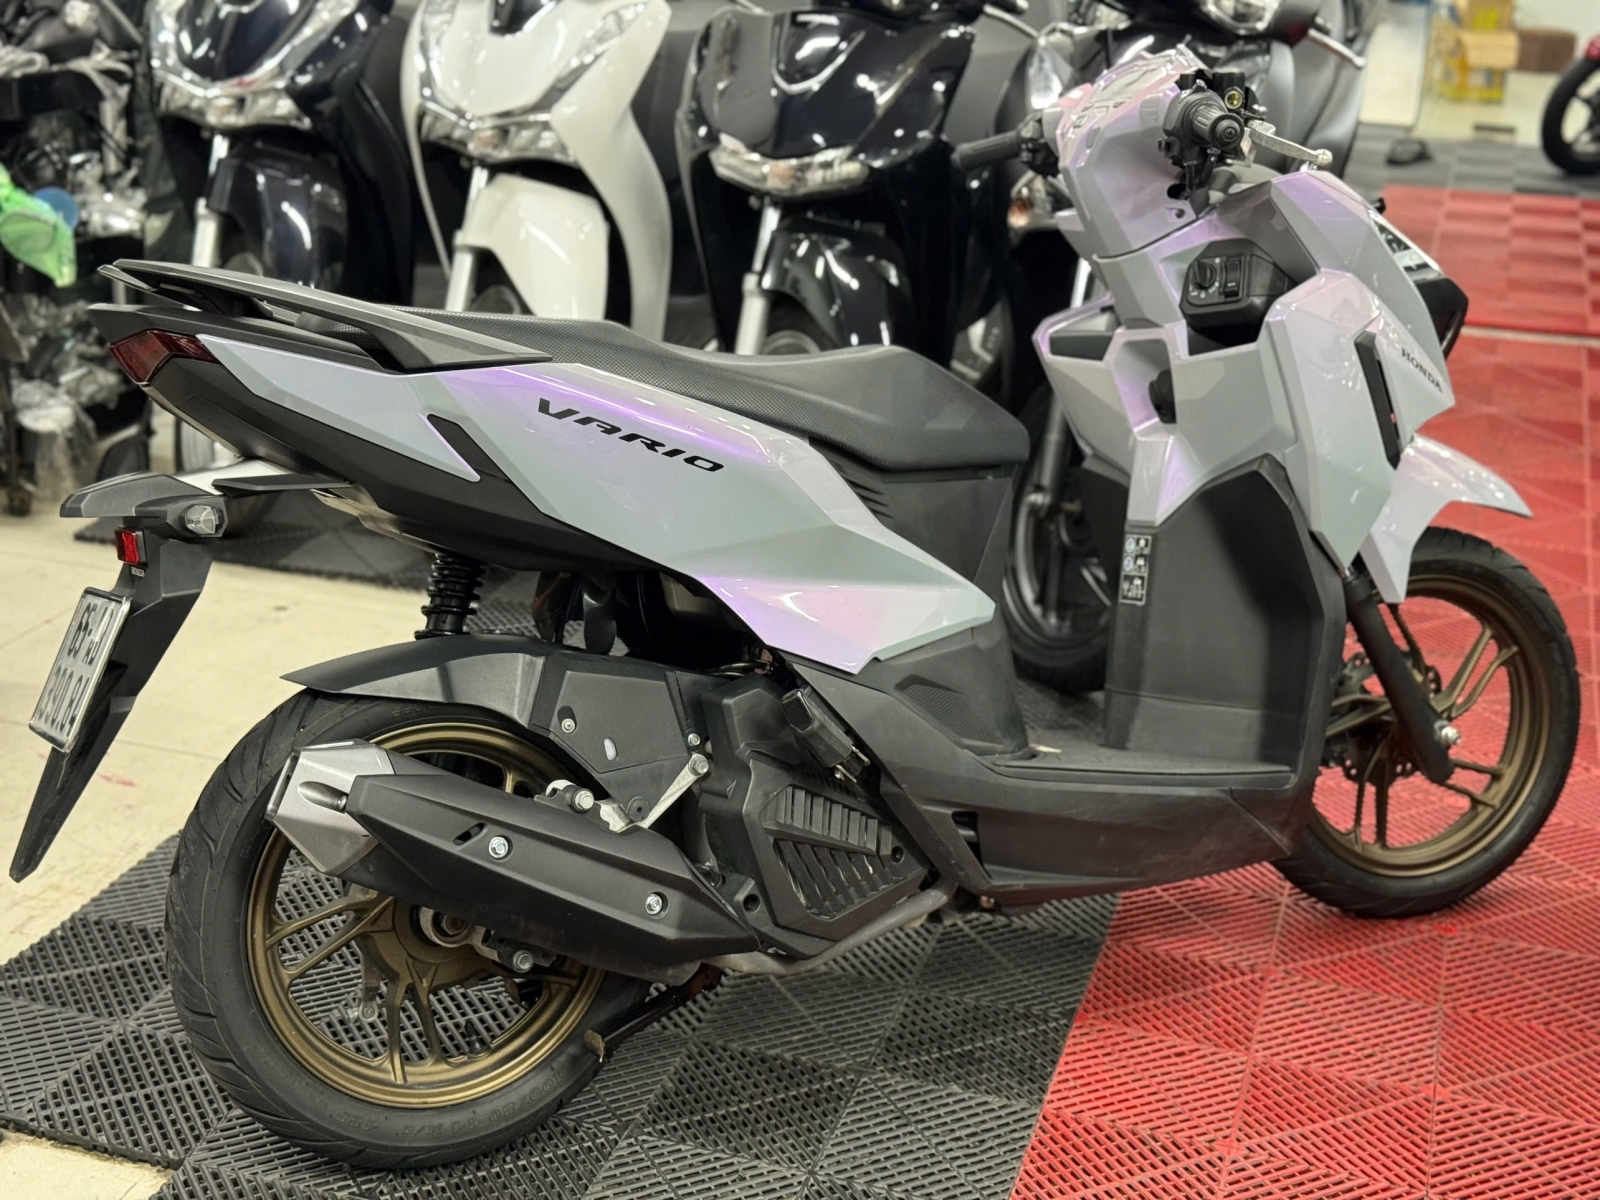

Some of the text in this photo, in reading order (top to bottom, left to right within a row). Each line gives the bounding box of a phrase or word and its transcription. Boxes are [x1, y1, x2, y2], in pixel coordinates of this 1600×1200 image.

[1401, 347, 1443, 394] HONDA
[538, 397, 724, 472] VARIO
[38, 664, 90, 737] 390.84
